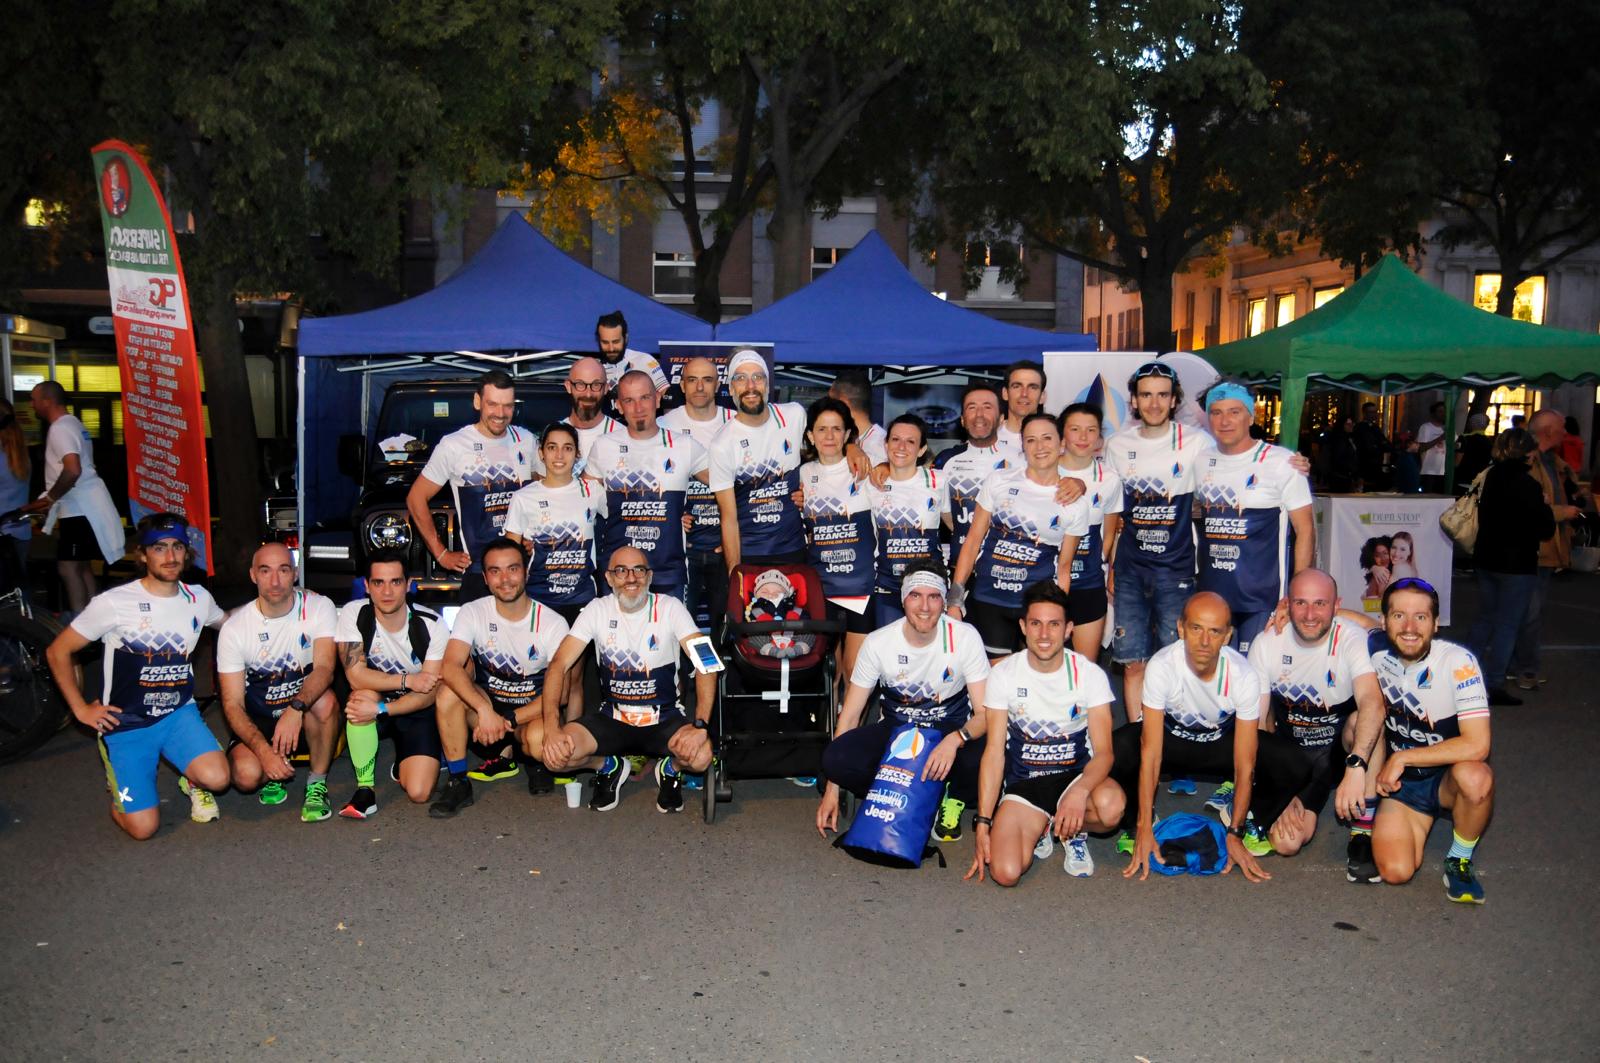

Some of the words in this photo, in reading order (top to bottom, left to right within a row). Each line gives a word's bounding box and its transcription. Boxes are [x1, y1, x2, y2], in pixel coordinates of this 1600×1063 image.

[484, 492, 513, 501] FREC
[484, 499, 510, 507] BIAN
[621, 501, 667, 509] FRECCE
[1132, 505, 1177, 513] FRECCE
[695, 516, 719, 526] Jeep
[753, 514, 780, 523] Jeep
[1205, 517, 1248, 527] FRECCE
[813, 523, 857, 533] FRECCE
[1205, 526, 1248, 535] BIANCHE
[814, 530, 857, 541] BIANCHE
[886, 538, 929, 547] FRECCE
[887, 546, 929, 554] BIANCHE
[995, 540, 1042, 557] FRECCE
[1139, 542, 1166, 554] Jeep
[547, 550, 587, 560] FRECCE
[993, 547, 1038, 562] BIANCHE
[545, 557, 587, 565] BIANCHE
[1212, 558, 1236, 572] Jeep
[826, 563, 853, 573] Jeep
[993, 579, 1023, 592] Jeep
[140, 663, 190, 675] FRECCE
[267, 677, 307, 693] FRECC
[609, 679, 656, 688] FRECCE
[610, 686, 656, 696] BIANCHE
[895, 706, 947, 717] FRECCE
[1385, 716, 1443, 746] Jeep
[1299, 737, 1333, 747] Jeep
[1021, 742, 1076, 753] FRECCE
[1021, 751, 1076, 761] BIANCHE
[864, 804, 895, 822] Jeep
